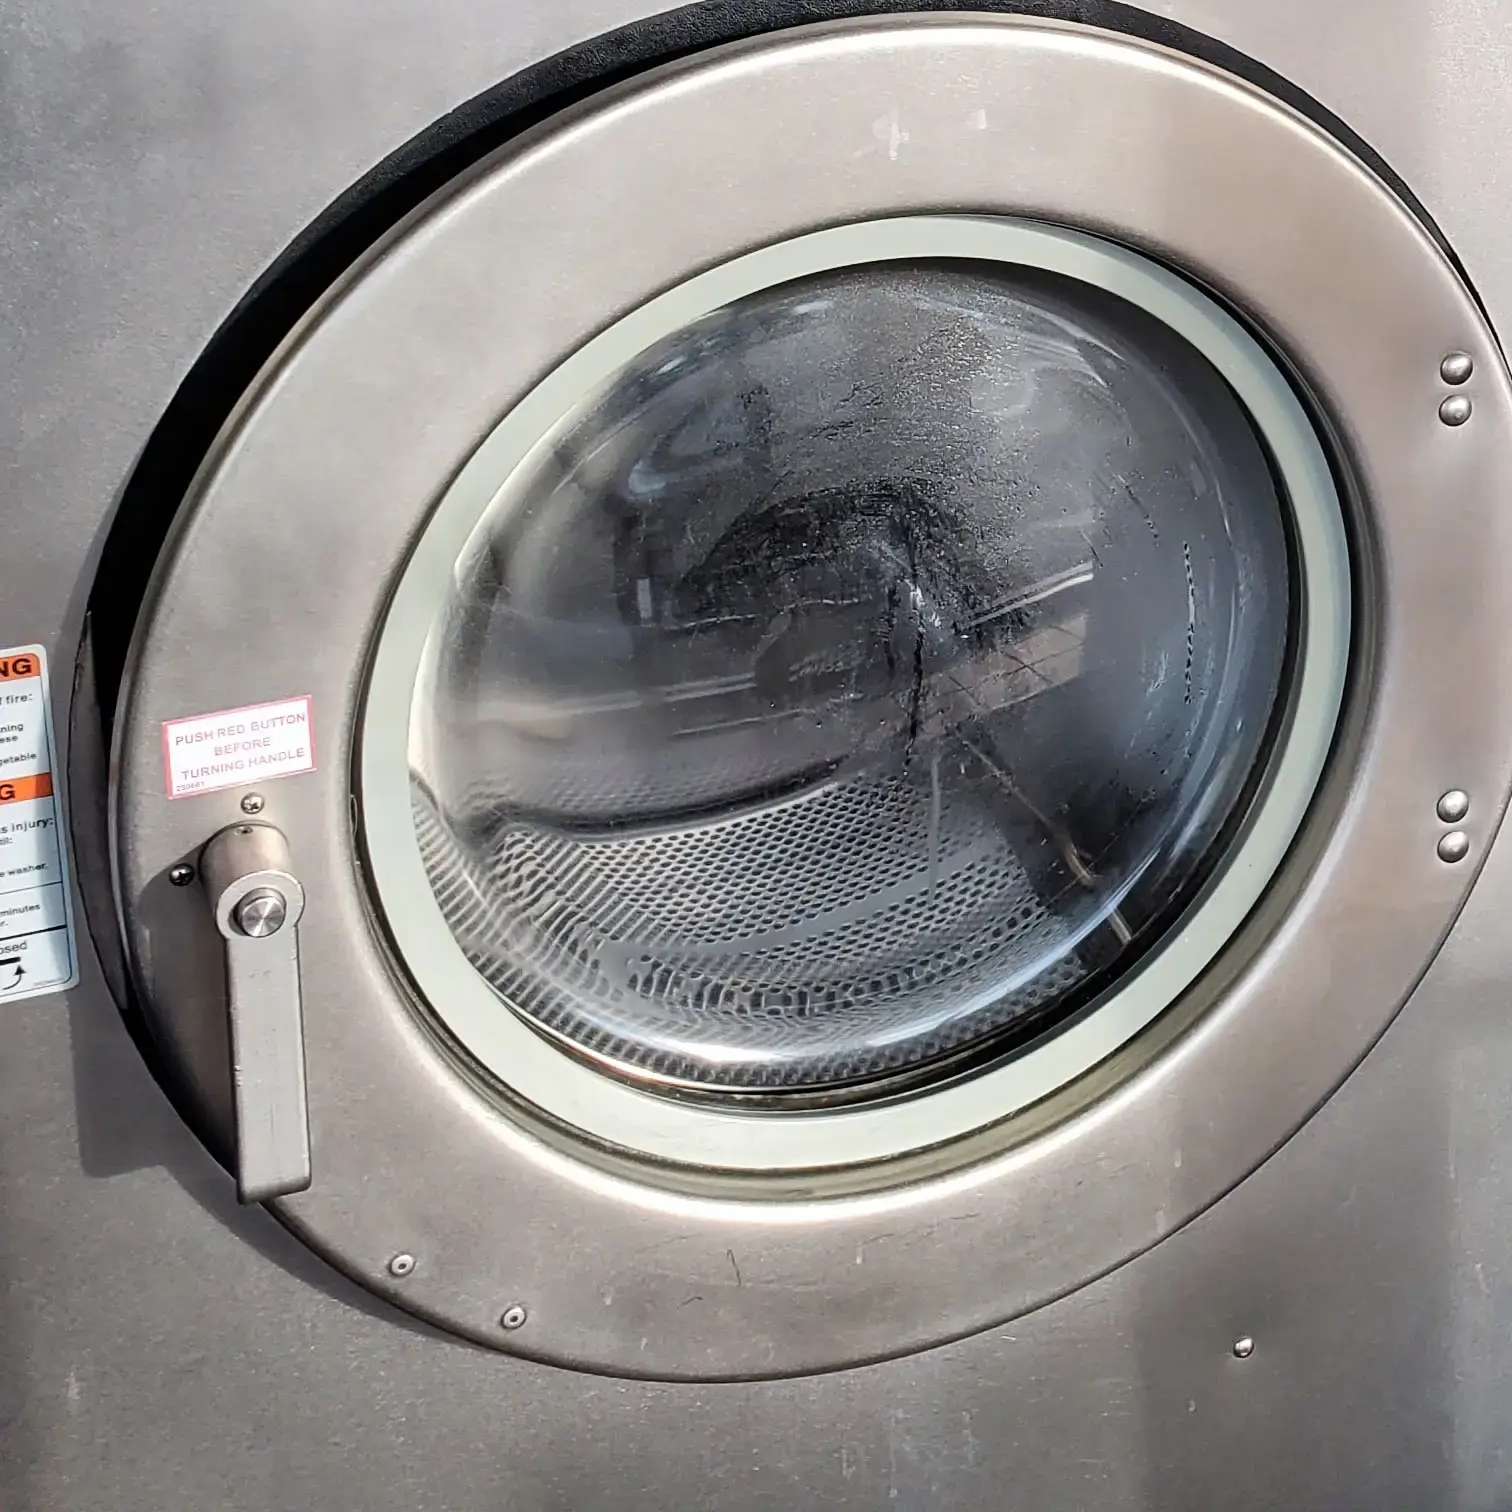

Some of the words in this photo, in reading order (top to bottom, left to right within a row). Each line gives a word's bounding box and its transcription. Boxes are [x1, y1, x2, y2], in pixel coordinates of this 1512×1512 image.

[6, 694, 32, 705] fire:
[176, 731, 213, 746] PUSH
[217, 724, 246, 737] RED
[251, 712, 305, 731] BUTTON
[214, 737, 271, 756] BEFORE
[182, 760, 244, 780] TURNING
[249, 748, 305, 767] HANDLE
[12, 816, 53, 833] injury:
[8, 863, 48, 876] washer.
